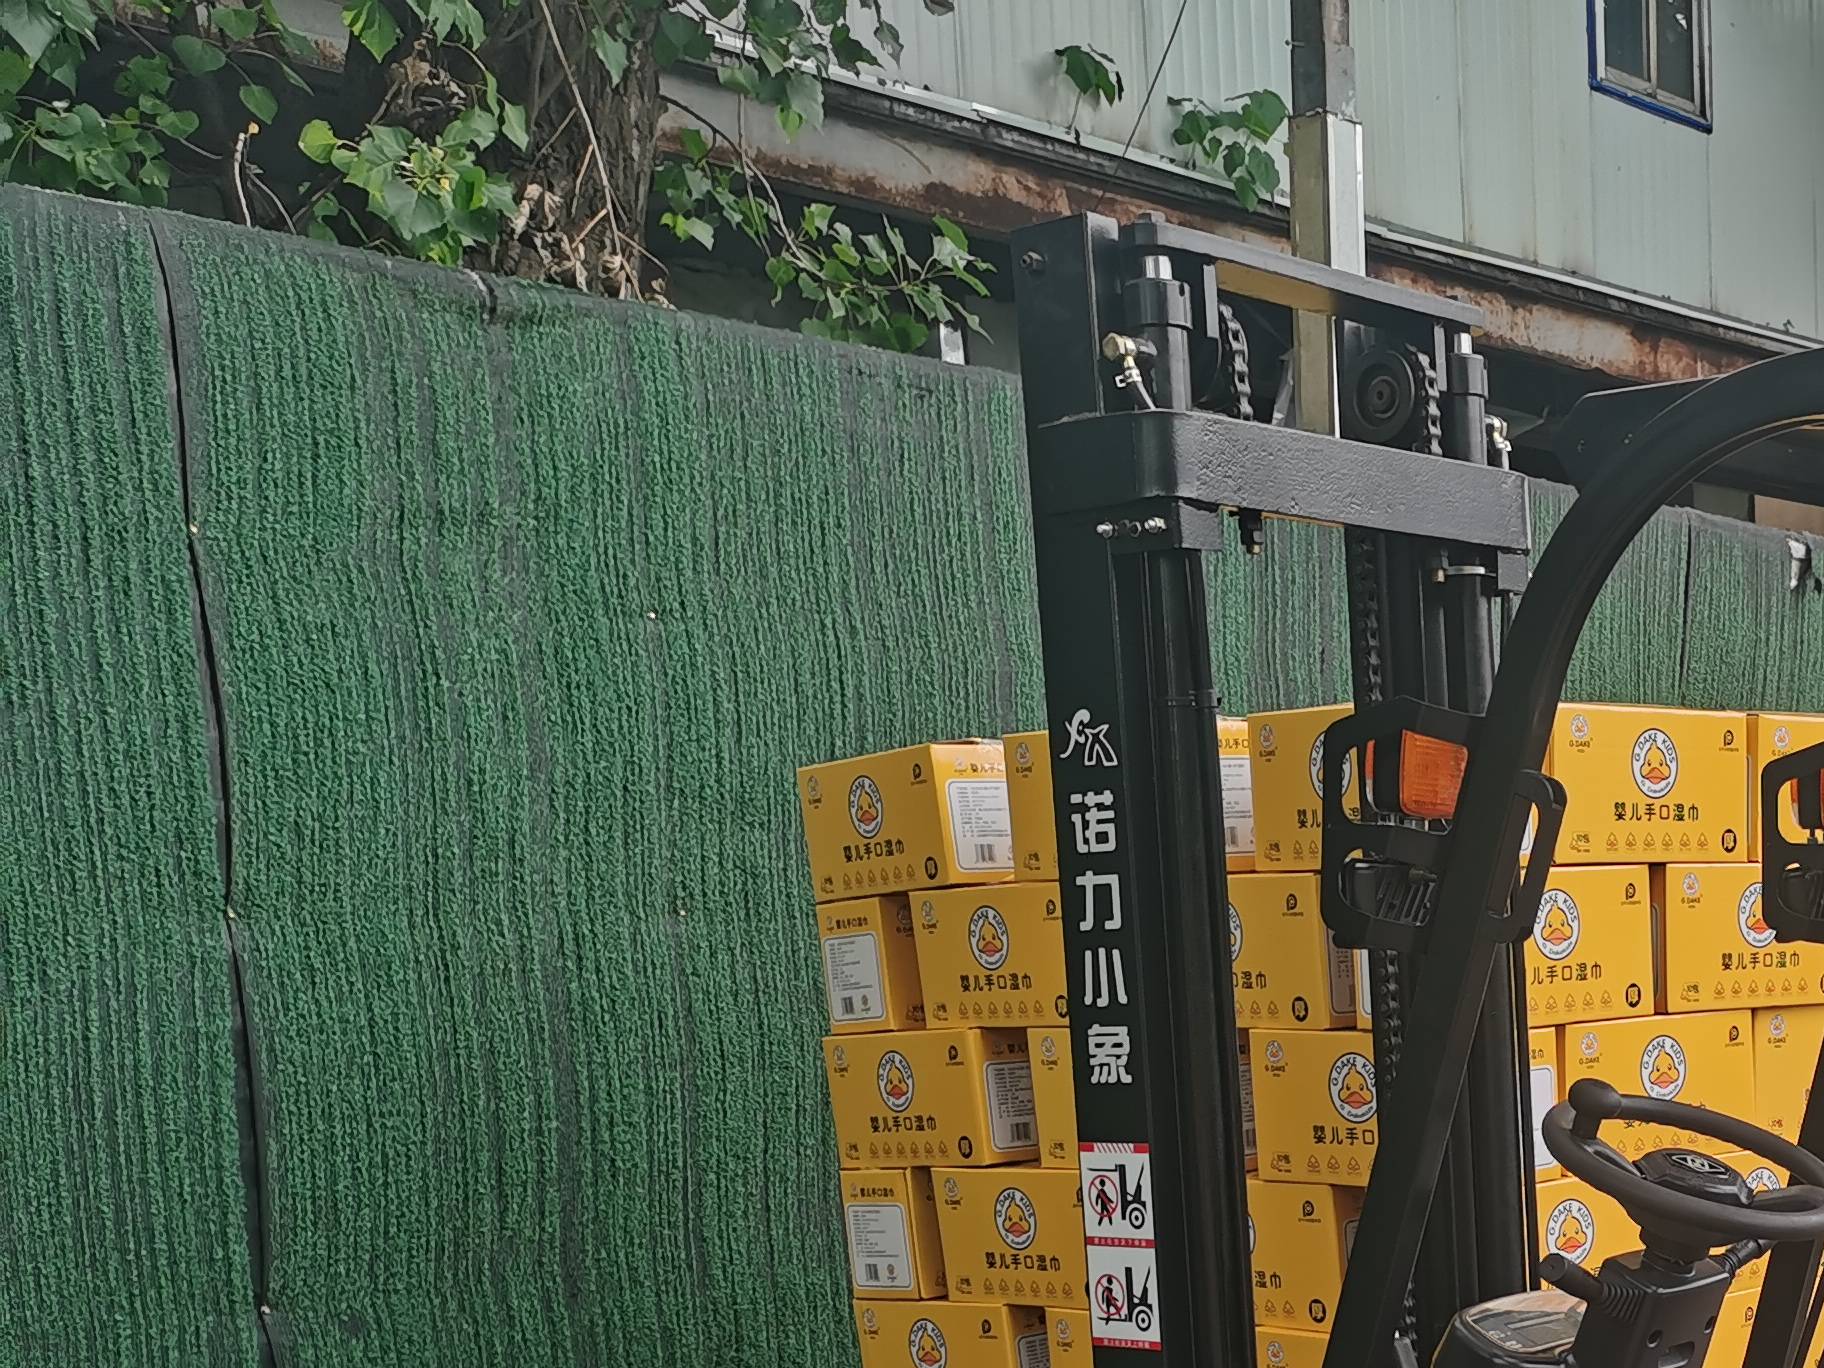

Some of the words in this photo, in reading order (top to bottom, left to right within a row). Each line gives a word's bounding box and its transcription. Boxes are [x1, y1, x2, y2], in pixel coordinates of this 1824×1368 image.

[1635, 732, 1659, 763] G.DAKE
[1661, 736, 1676, 764] KIDS
[1615, 802, 1699, 821] 婴儿手口湿巾
[843, 839, 904, 863] 婴儿手口湿巾
[1562, 895, 1578, 924] KIDS
[1069, 790, 1133, 1085] 诺力小象
[1721, 950, 1800, 970] 婴儿手口湿巾
[960, 973, 1032, 992] 婴儿手口湿巾
[1531, 961, 1602, 985] 儿手口湿巾
[1643, 1039, 1667, 1070] G.DAKE
[1670, 1042, 1684, 1067] KIDS
[870, 1115, 937, 1133] 婴儿手口湿巾
[1313, 1125, 1375, 1145] 婴儿手口
[1577, 1204, 1592, 1231] KIDS
[985, 1252, 1061, 1272] 婴儿手口湿巾
